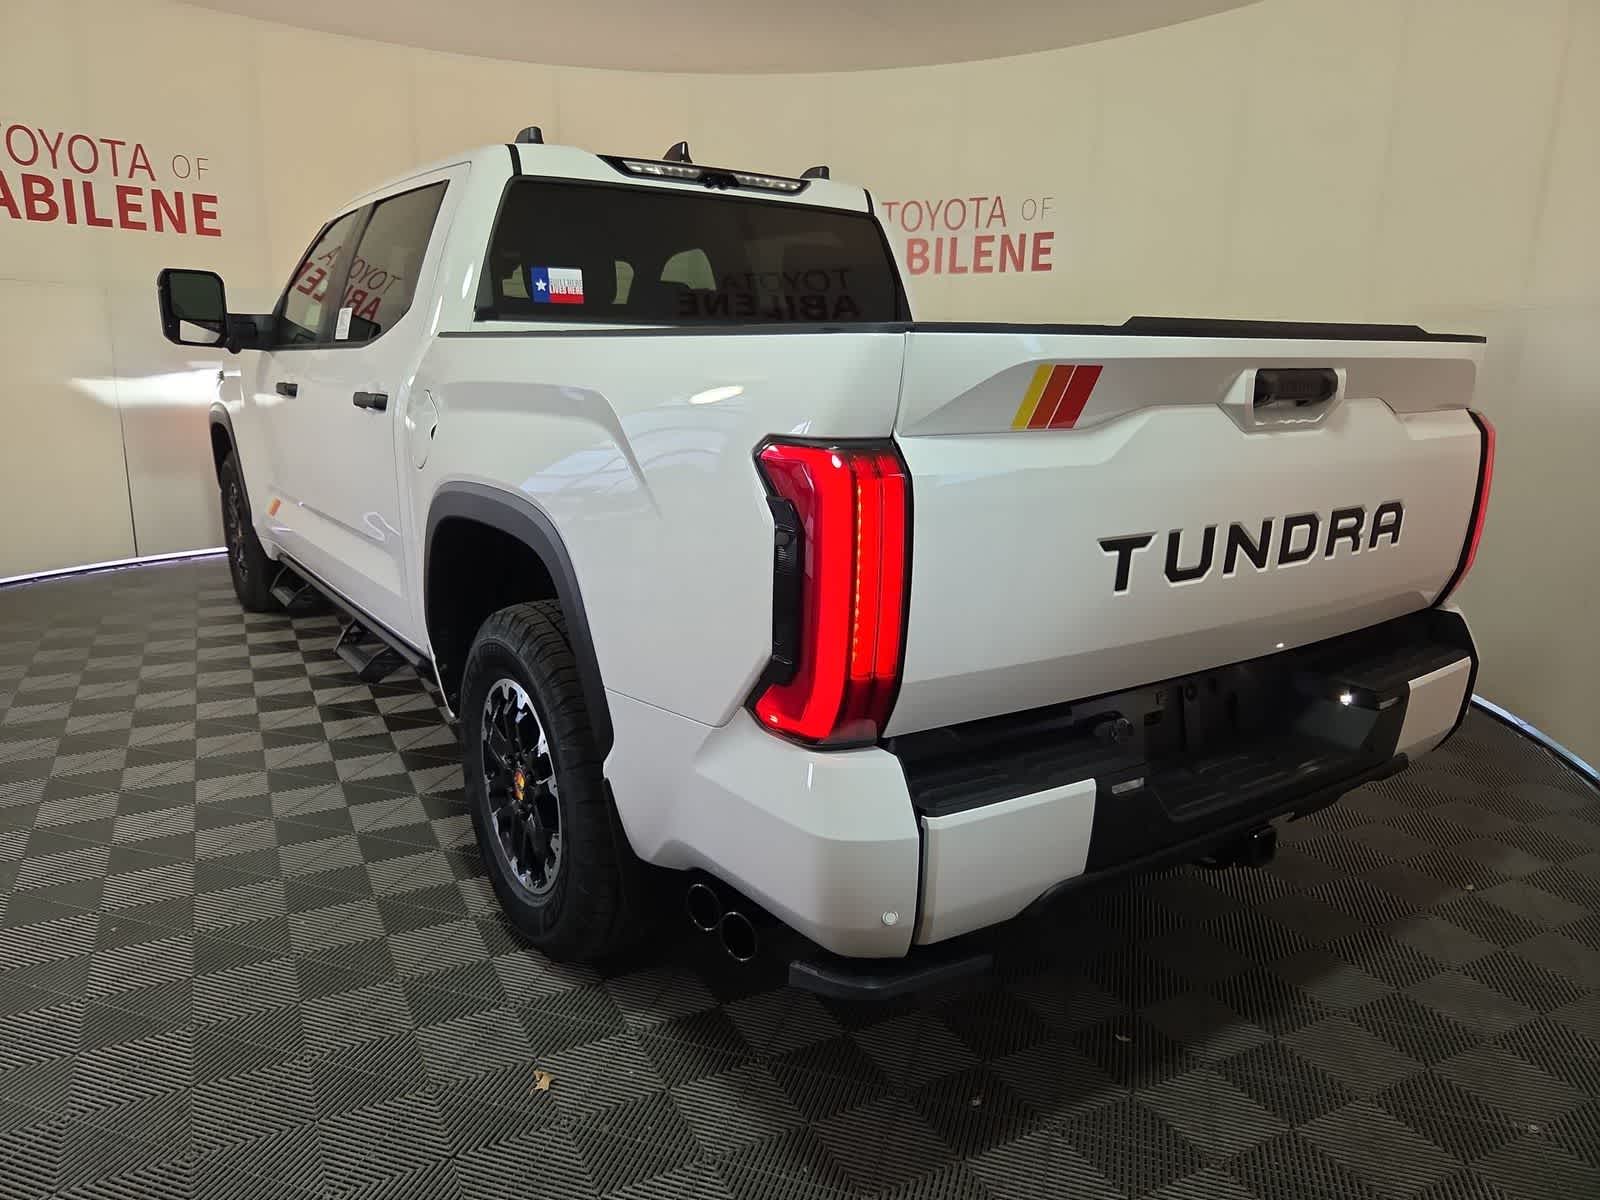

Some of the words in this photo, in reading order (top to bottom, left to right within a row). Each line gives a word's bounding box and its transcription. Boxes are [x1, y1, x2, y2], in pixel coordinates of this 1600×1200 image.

[0, 123, 156, 181] OYOTA
[172, 154, 209, 180] OF
[882, 196, 1006, 232] TOYOTA
[1021, 197, 1054, 221] OF
[905, 232, 1054, 276] BILENE
[1099, 500, 1405, 596] TUNDRA
